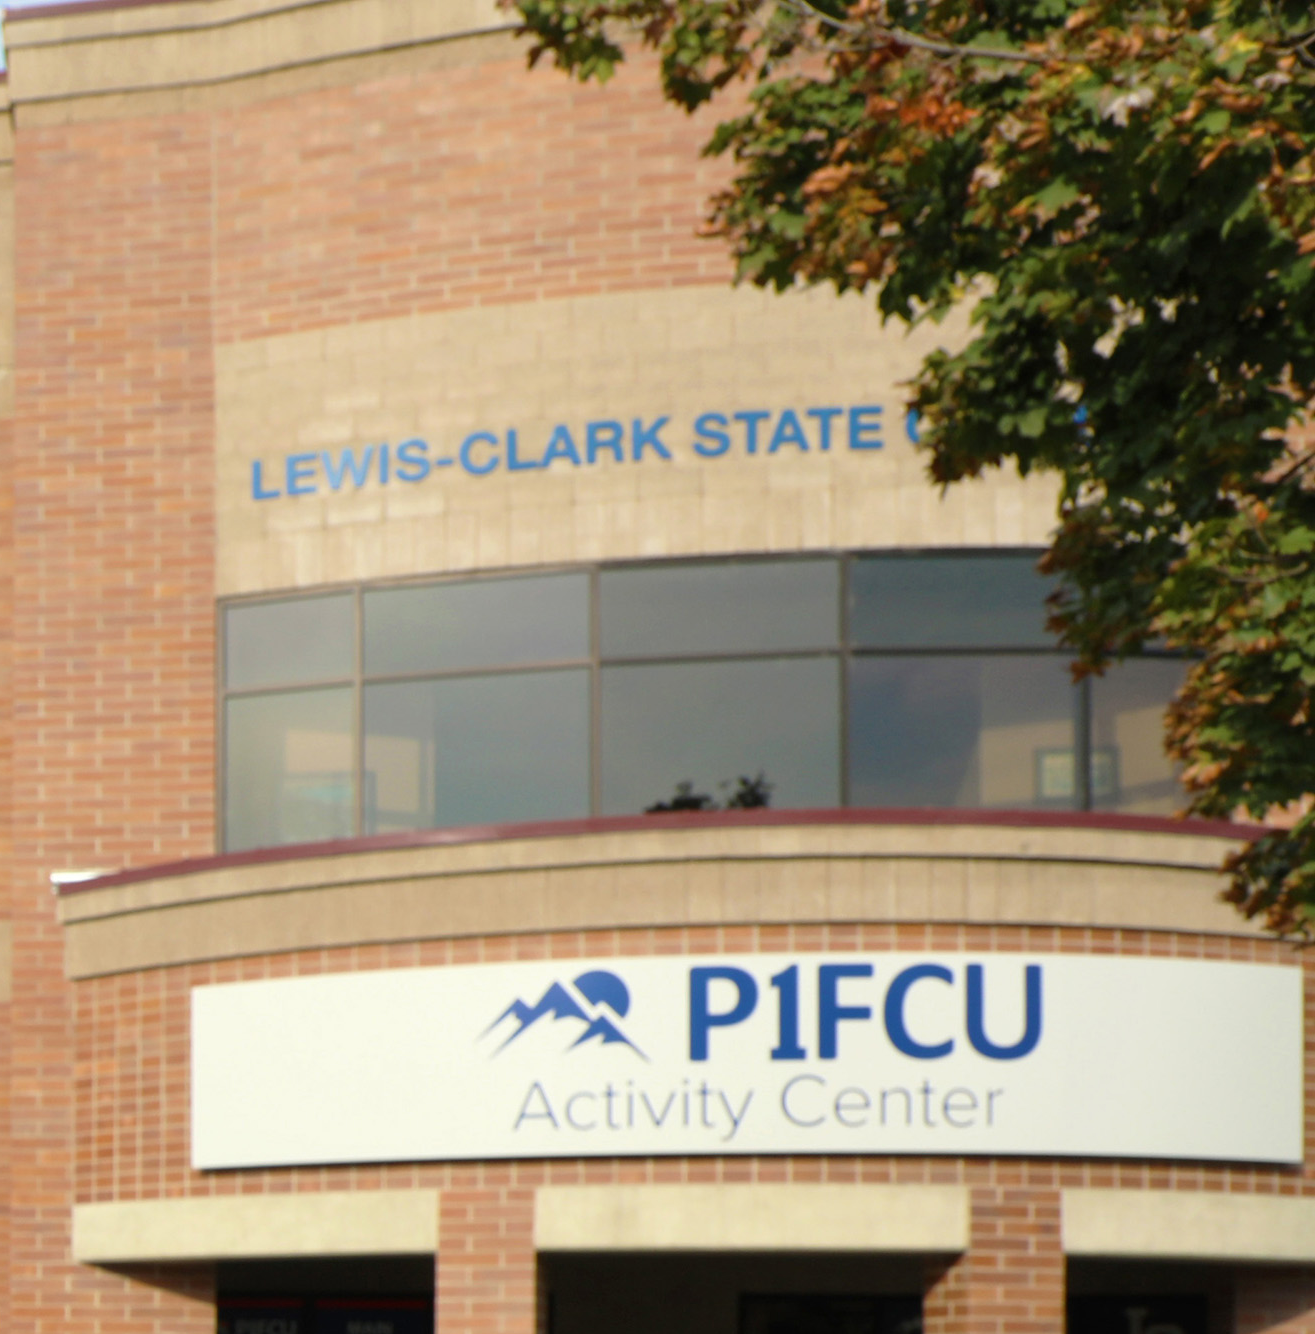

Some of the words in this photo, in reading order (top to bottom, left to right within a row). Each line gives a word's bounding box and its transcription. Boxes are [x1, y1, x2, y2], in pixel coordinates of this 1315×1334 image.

[250, 414, 672, 500] LEWIS-CLARK
[691, 405, 885, 457] STATE
[688, 963, 1045, 1062] P1FCU
[512, 1076, 756, 1145] Activity
[779, 1073, 1006, 1133] Center
